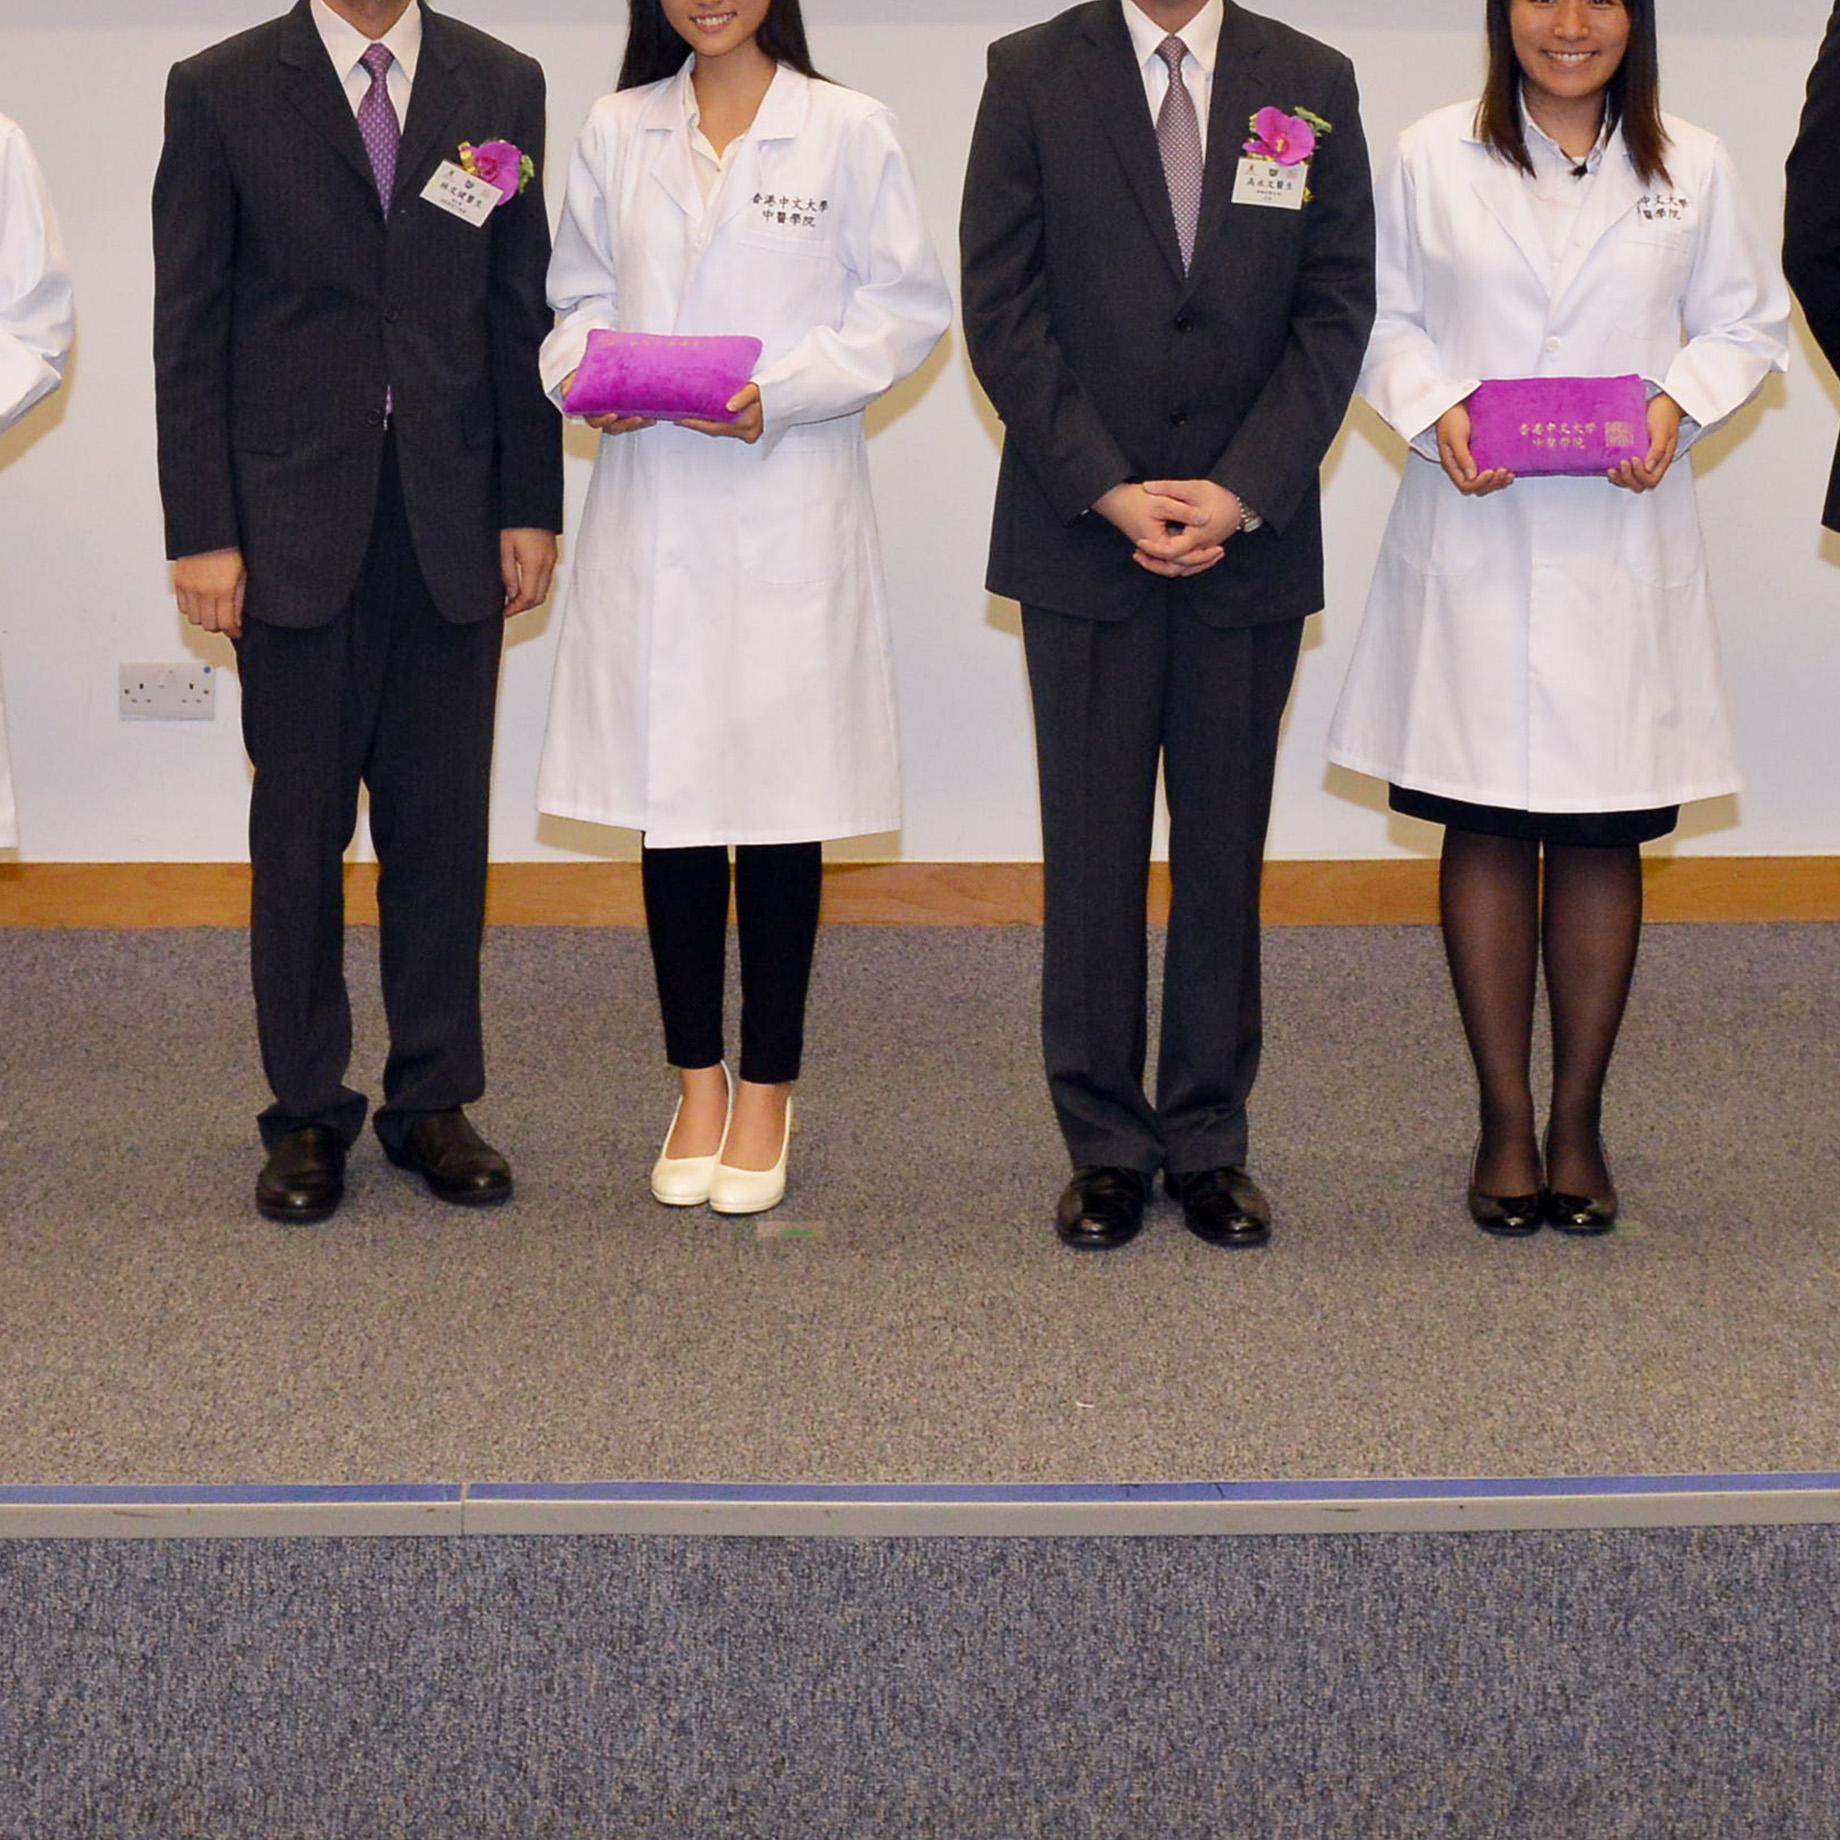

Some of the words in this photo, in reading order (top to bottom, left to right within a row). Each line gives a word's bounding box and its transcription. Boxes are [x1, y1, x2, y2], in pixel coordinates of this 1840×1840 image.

[752, 192, 829, 213] 香港中文大學
[762, 208, 816, 228] 中醫學院
